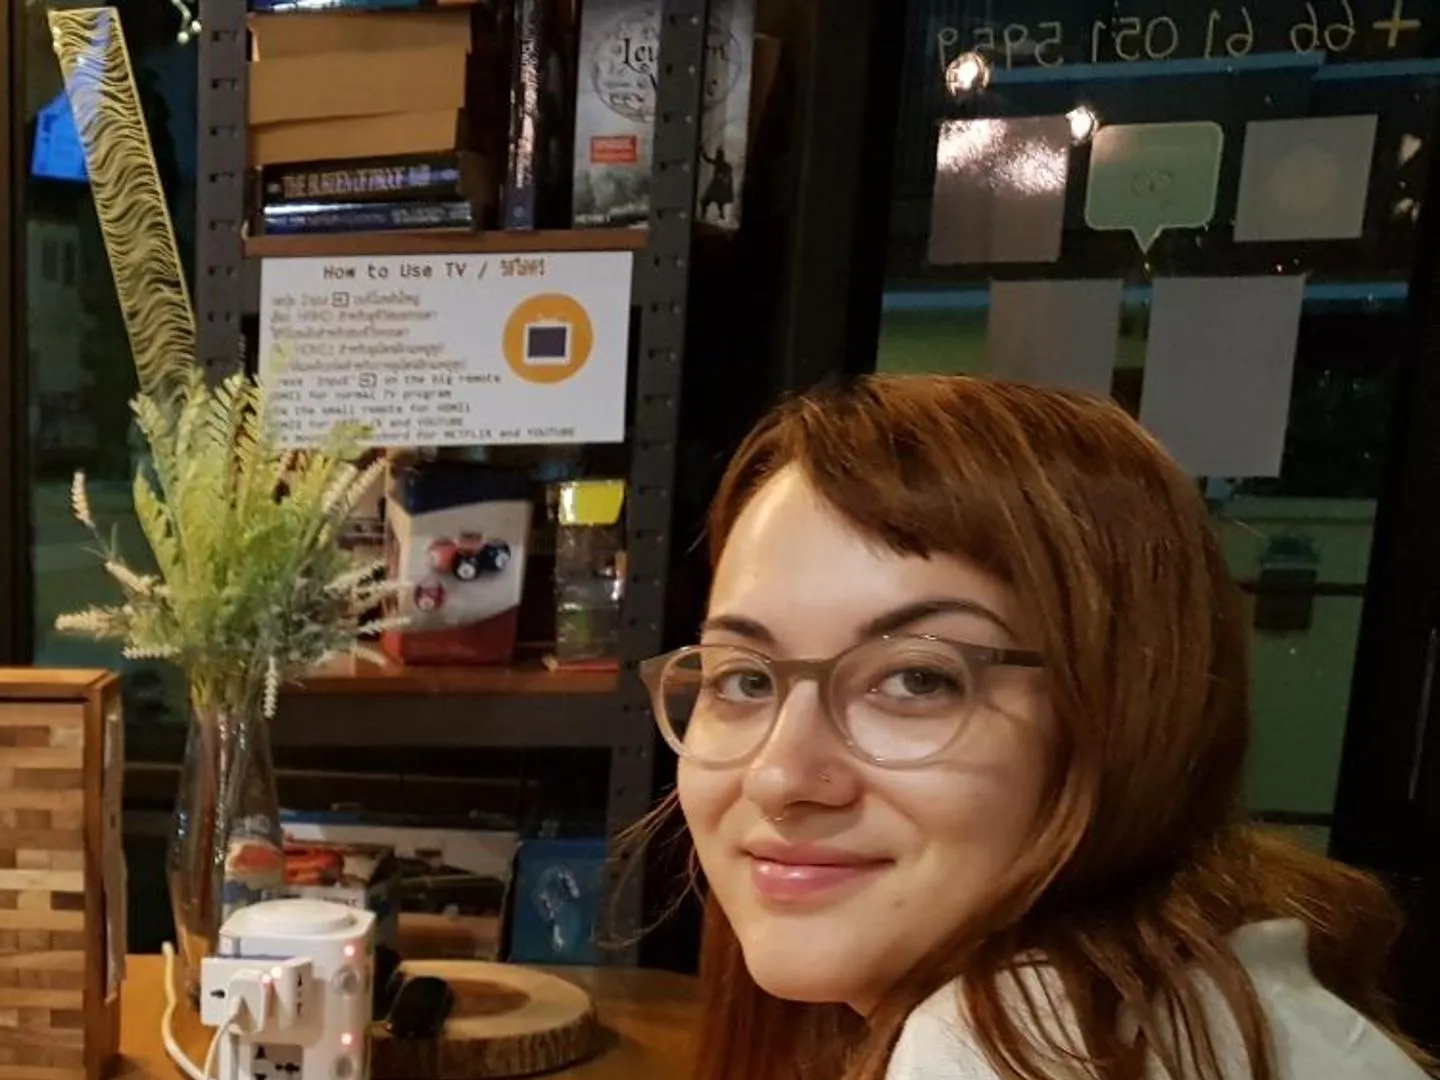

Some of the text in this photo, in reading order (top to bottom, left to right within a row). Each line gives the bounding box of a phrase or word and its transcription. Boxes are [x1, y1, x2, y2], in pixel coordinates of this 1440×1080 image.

[323, 264, 356, 280] How
[368, 263, 389, 279] to
[400, 262, 433, 278] Use
[445, 261, 468, 278] TV
